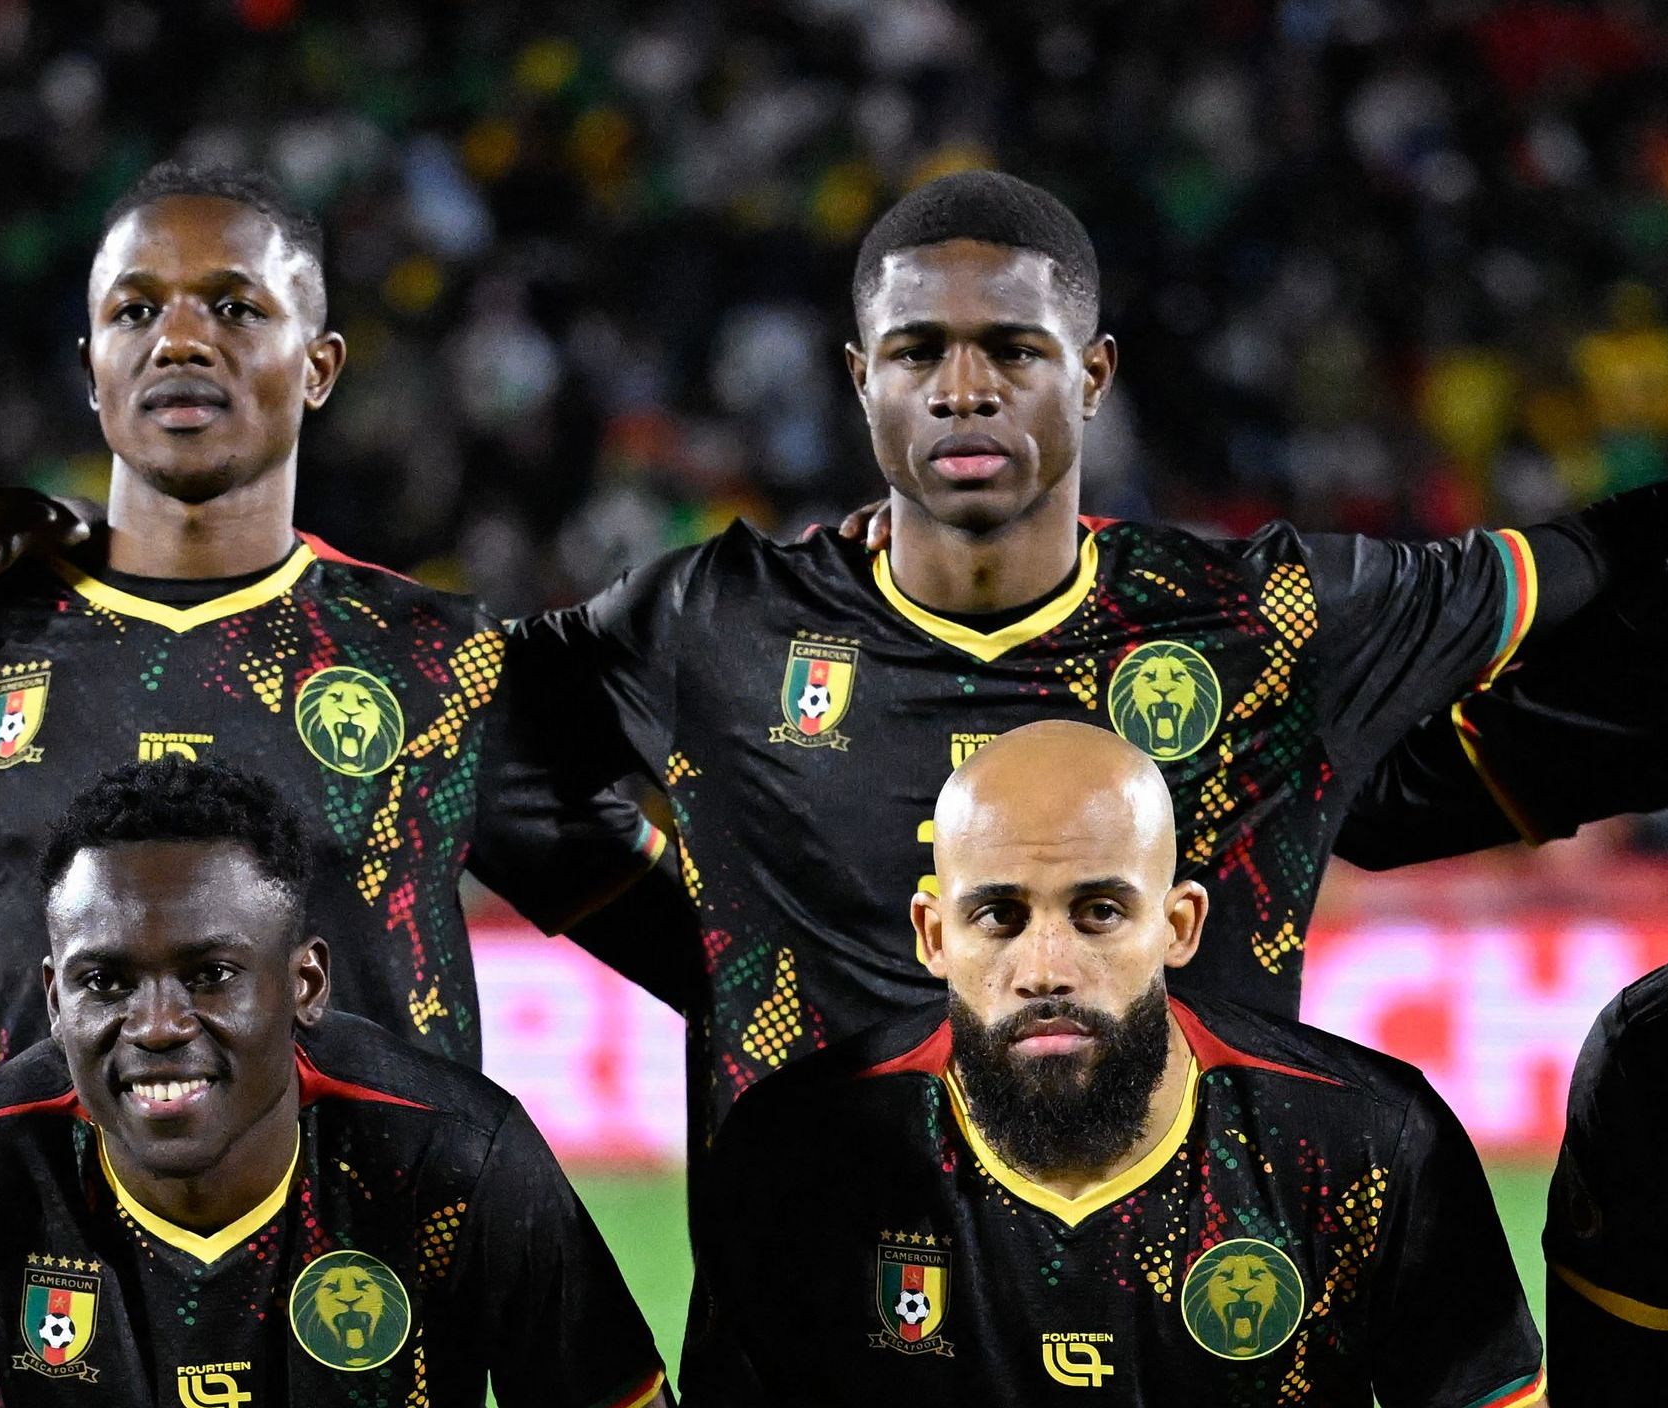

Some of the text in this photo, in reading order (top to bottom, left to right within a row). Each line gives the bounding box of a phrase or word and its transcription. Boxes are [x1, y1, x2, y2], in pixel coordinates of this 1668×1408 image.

[795, 647, 852, 660] CAMEROUN
[139, 732, 214, 744] FOURTEEN
[950, 733, 999, 744] FOURT
[883, 1250, 945, 1265] CAMEROUN
[31, 1273, 95, 1292] CAMEROUN
[1042, 1332, 1115, 1344] FOURTEEN
[28, 1355, 83, 1375] FECAFOOT
[177, 1360, 252, 1376] FOURTEEN
